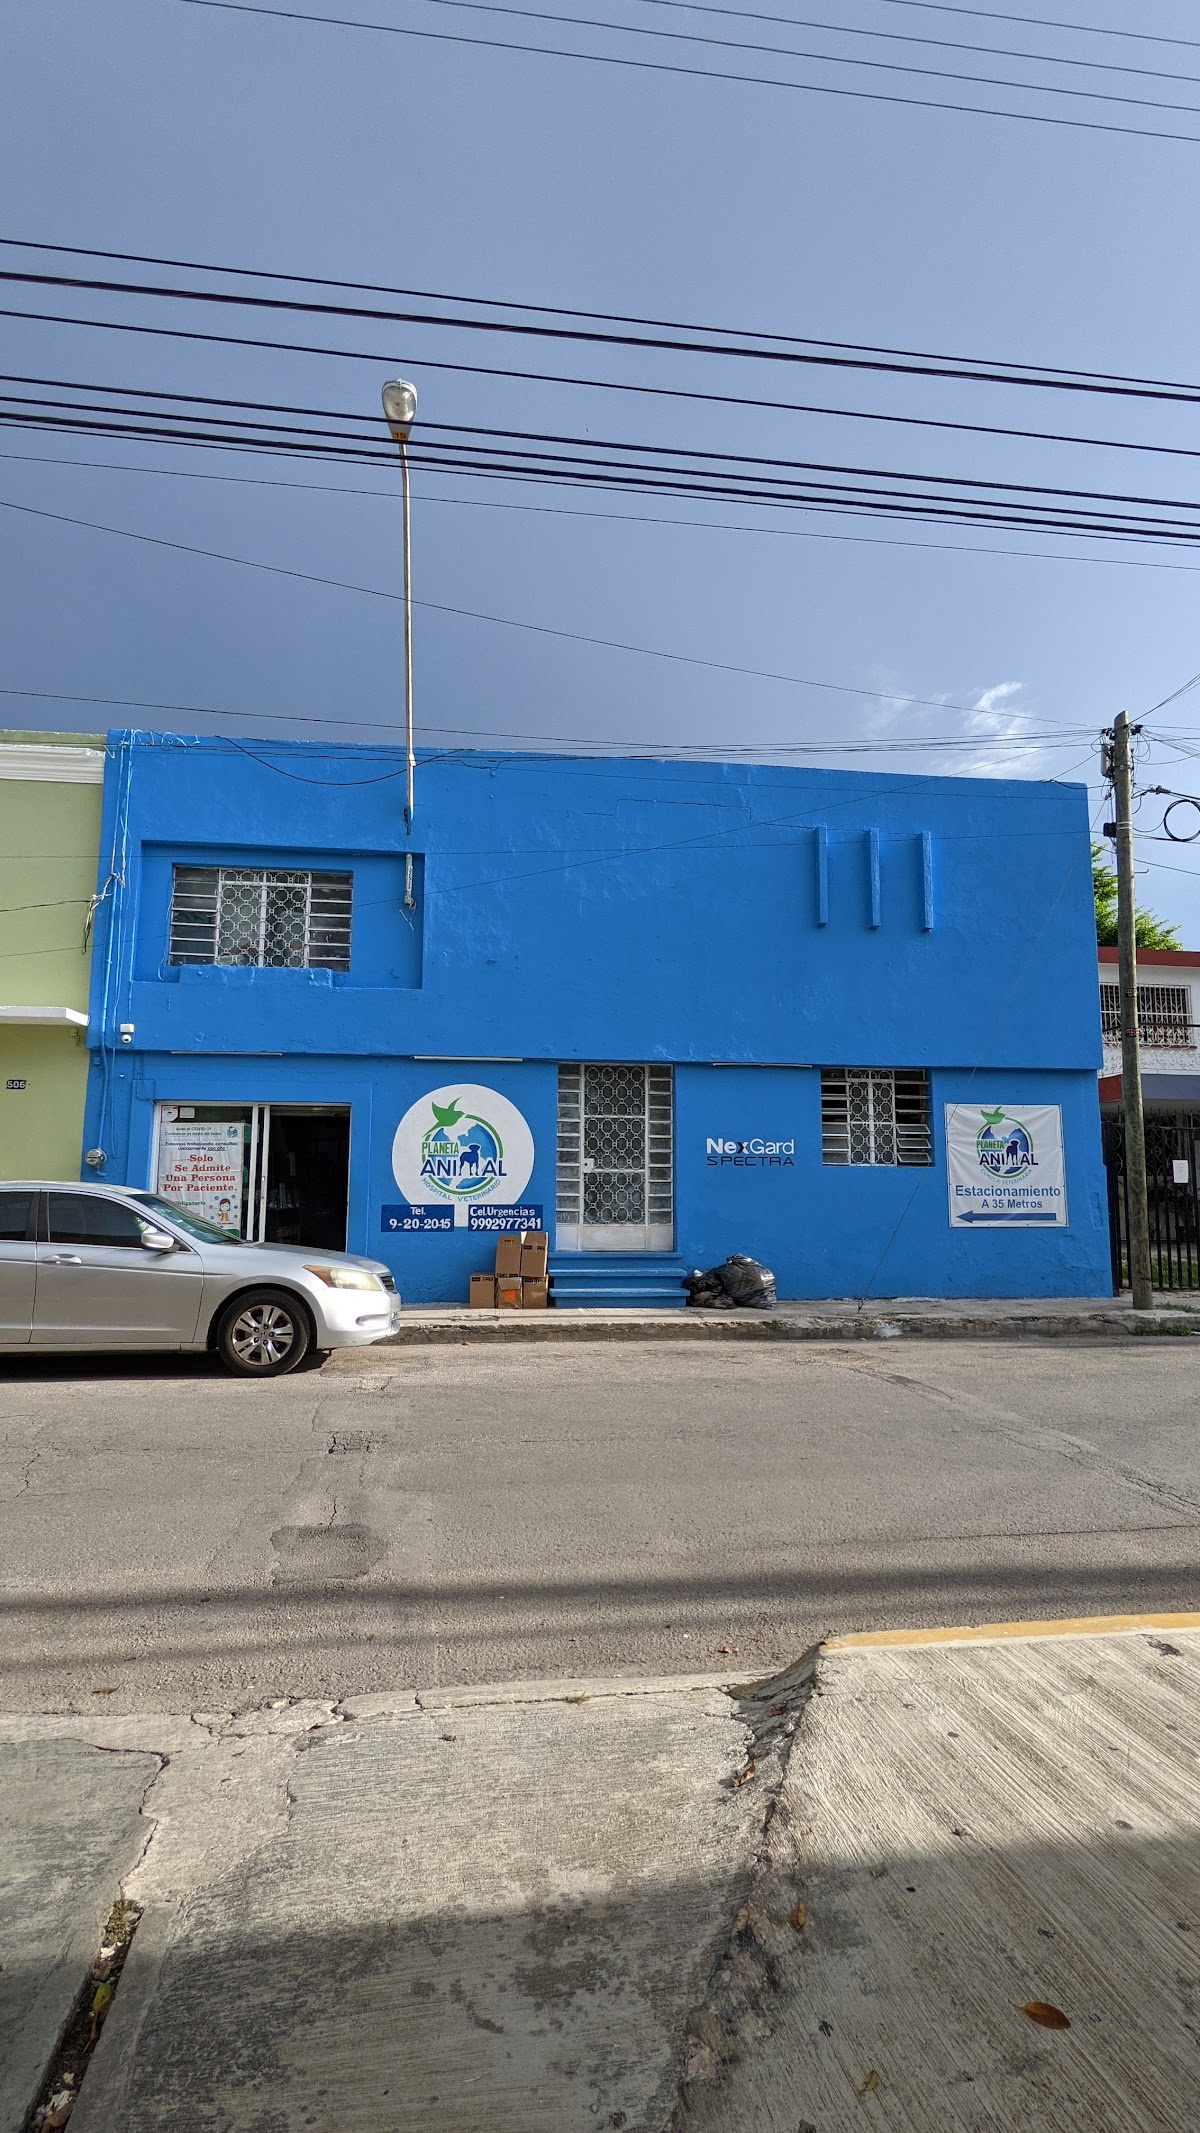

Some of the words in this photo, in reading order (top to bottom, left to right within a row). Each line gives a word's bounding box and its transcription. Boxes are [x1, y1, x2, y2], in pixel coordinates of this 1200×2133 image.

[7, 1080, 26, 1089] 506
[422, 1140, 460, 1154] PLANETA
[706, 1138, 795, 1154] NexGard
[976, 1139, 1004, 1149] PLANETA
[189, 1154, 214, 1163] Solo
[706, 1156, 795, 1166] SPECTRA
[174, 1164, 188, 1172] Se
[191, 1164, 231, 1172] Admite
[165, 1174, 187, 1182] Una
[191, 1174, 236, 1182] Persona
[1001, 1168, 1033, 1186] VETERINARIA
[163, 1184, 183, 1192] Por
[186, 1184, 237, 1192] Paciente.
[421, 1177, 453, 1201] HOSPITAL
[457, 1178, 502, 1202] VETERINARIO
[955, 1185, 1061, 1197] Estacionamiento
[981, 1198, 990, 1209] A
[992, 1198, 1004, 1209] 35
[1007, 1198, 1043, 1209] Metros
[410, 1206, 427, 1215] Tel.
[470, 1218, 541, 1230] 9992977341
